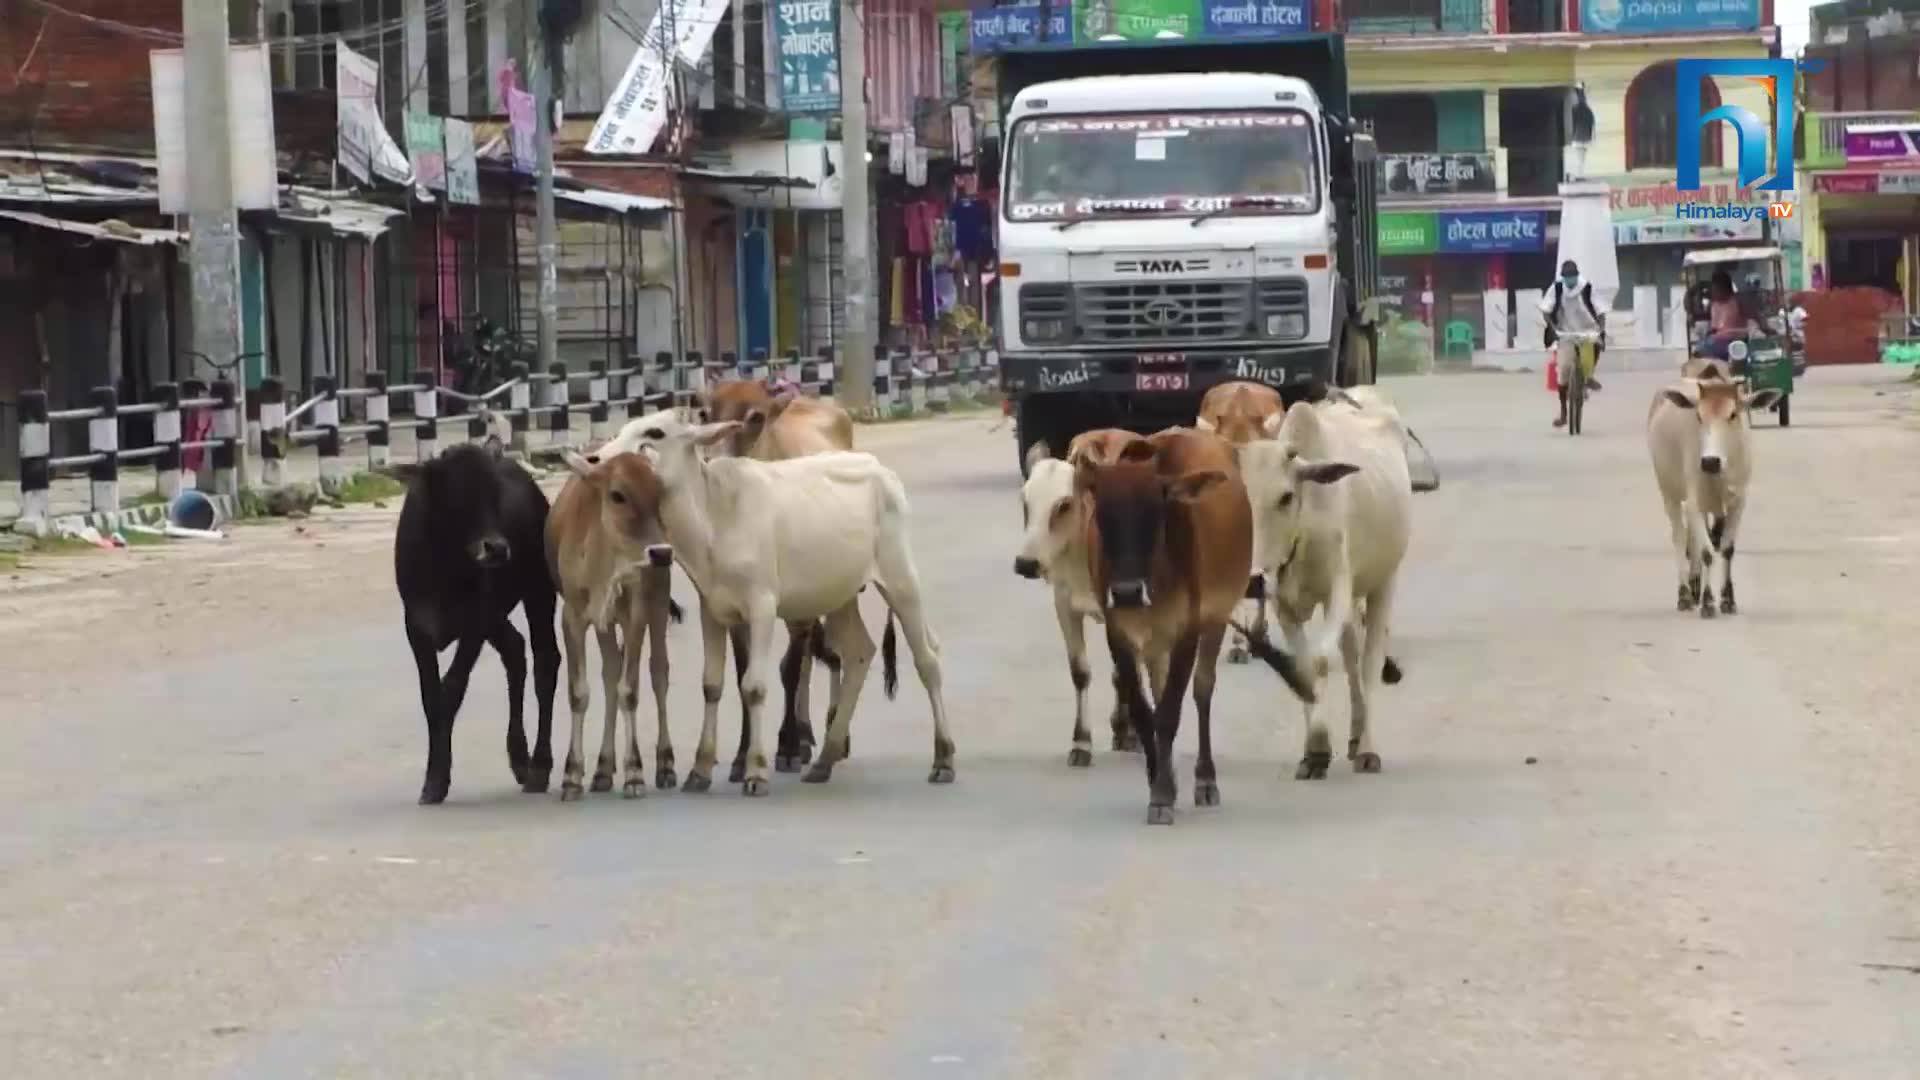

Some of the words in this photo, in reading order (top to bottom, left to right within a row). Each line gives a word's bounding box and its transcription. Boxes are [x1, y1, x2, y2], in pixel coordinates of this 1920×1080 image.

[1261, 1, 1302, 25] होटल
[1447, 217, 1487, 241] होटल
[1139, 260, 1184, 273] TATA
